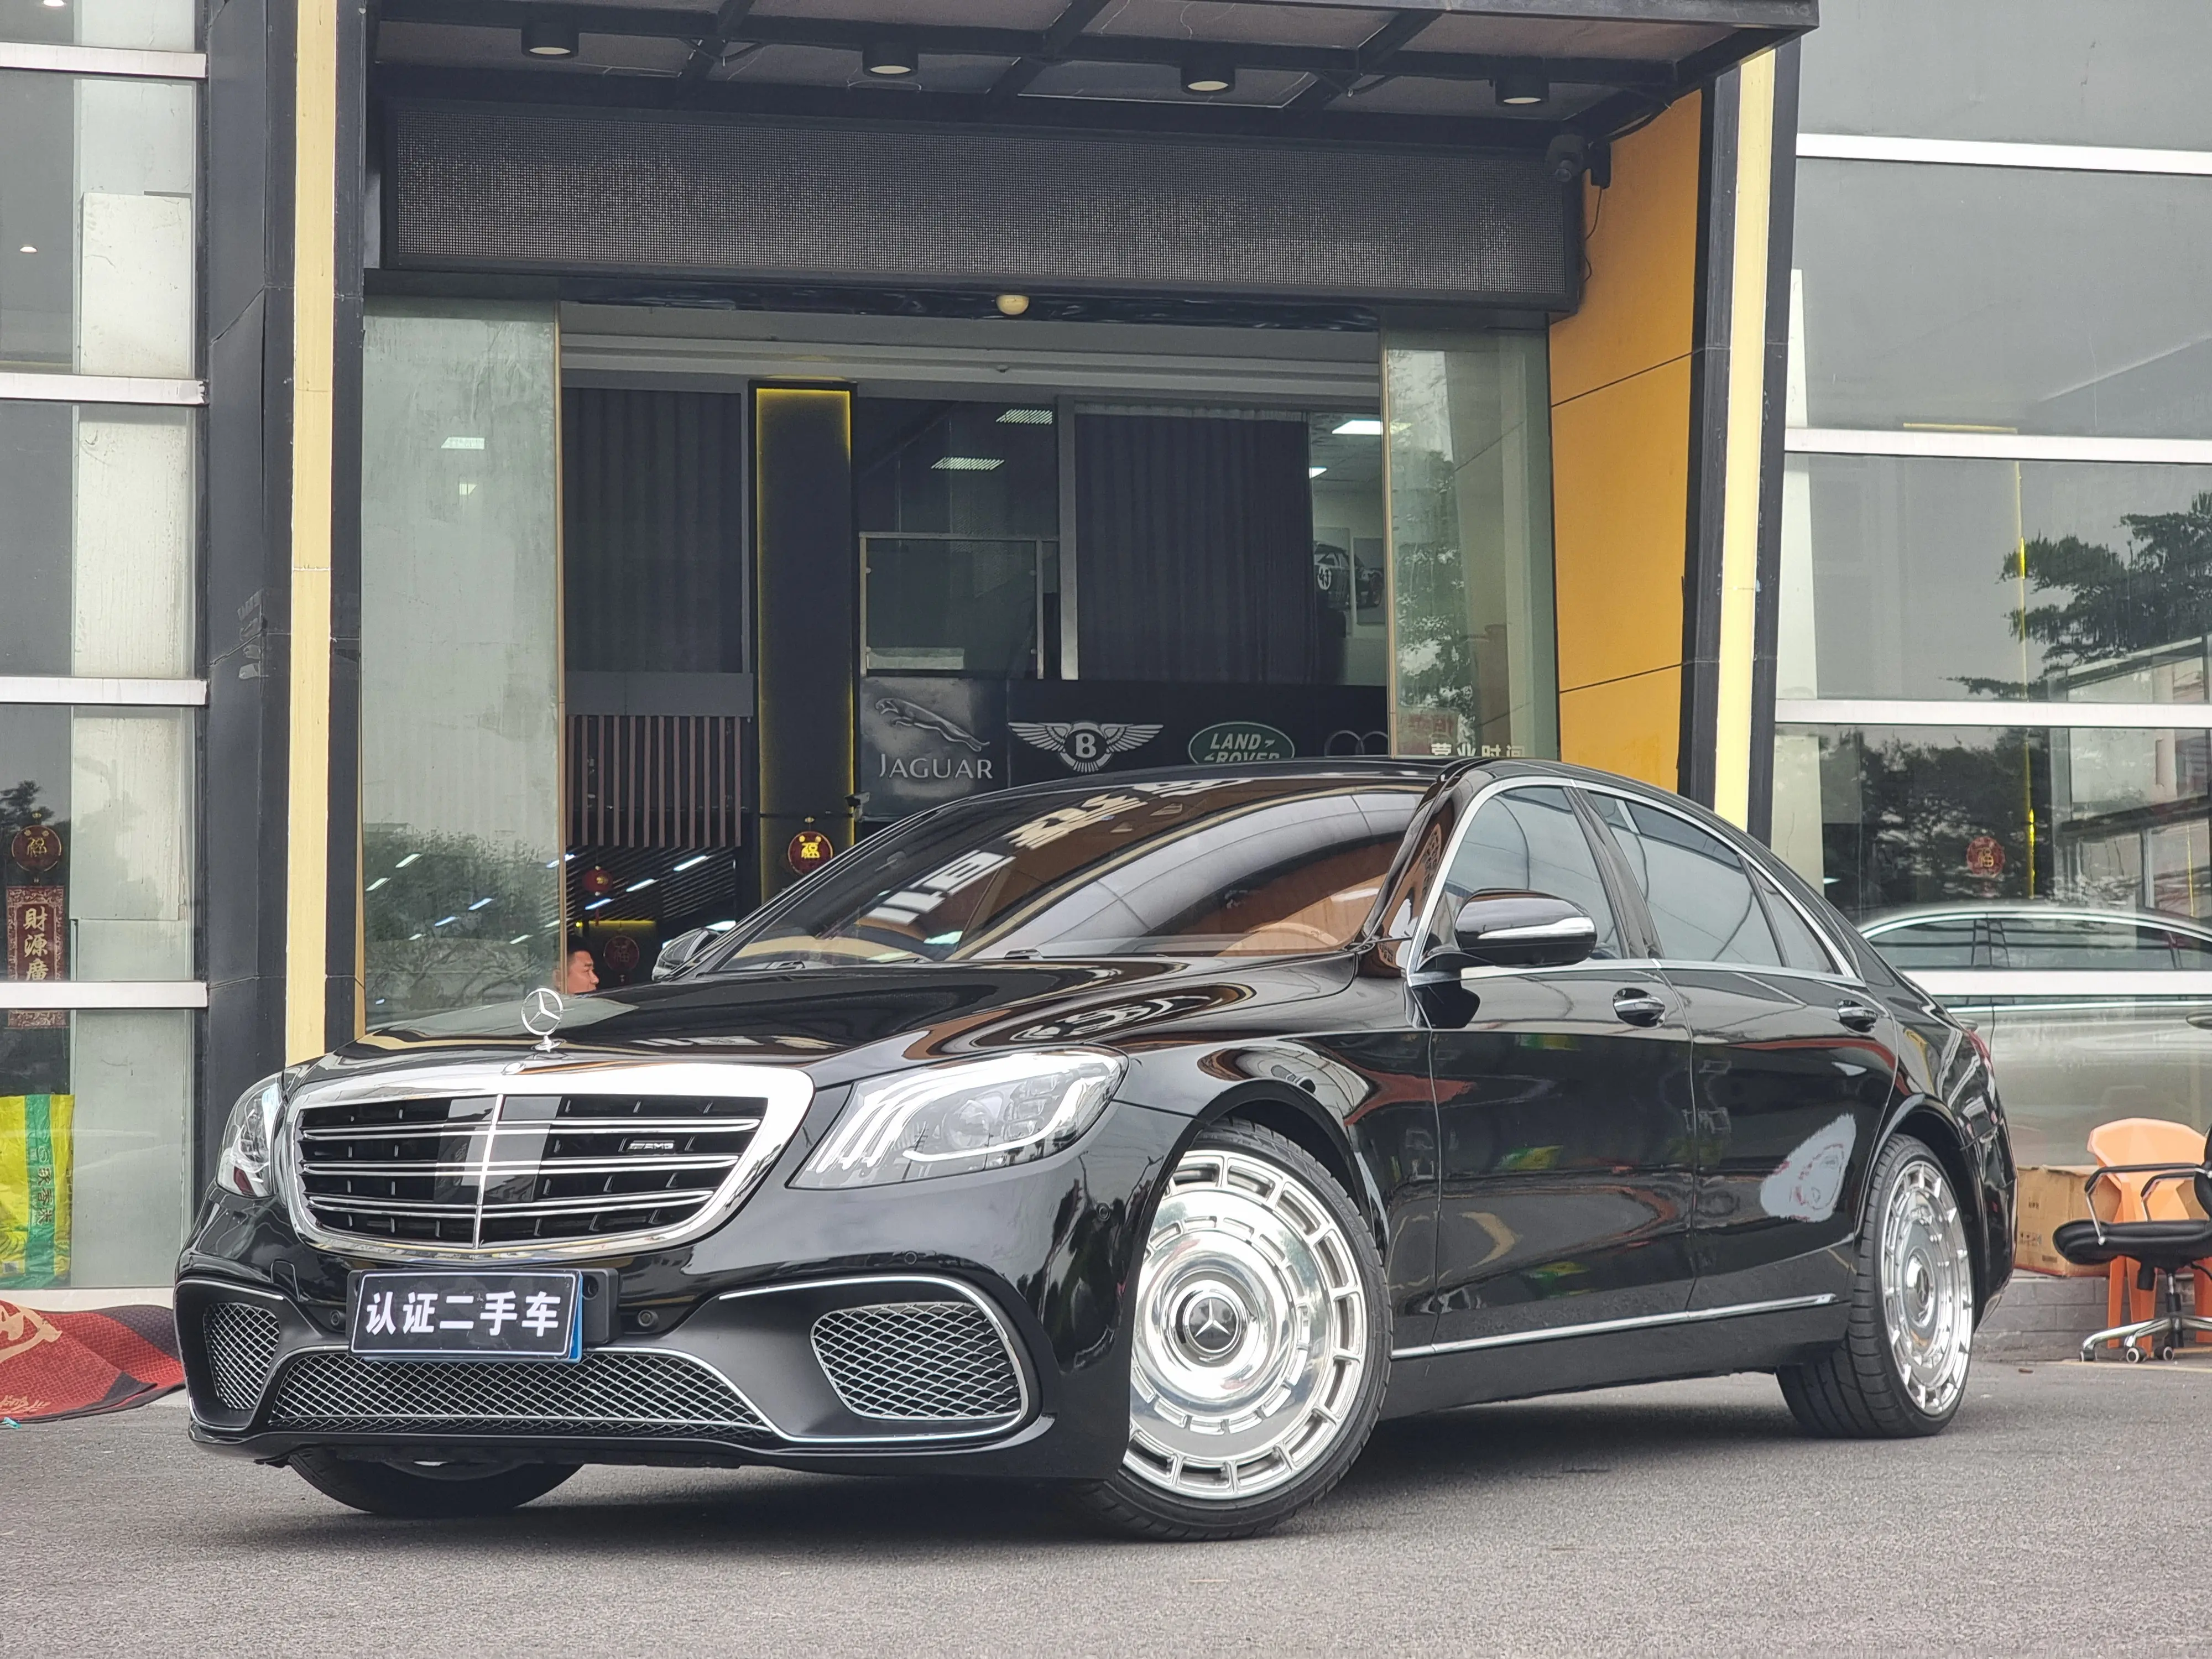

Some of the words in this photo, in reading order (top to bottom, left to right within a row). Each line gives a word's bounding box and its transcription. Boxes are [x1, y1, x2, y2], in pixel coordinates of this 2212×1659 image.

[1076, 733, 1097, 758] B
[1210, 733, 1261, 750] LAND
[880, 754, 993, 779] JAGUAR
[366, 1291, 561, 1337] 认证二手车
